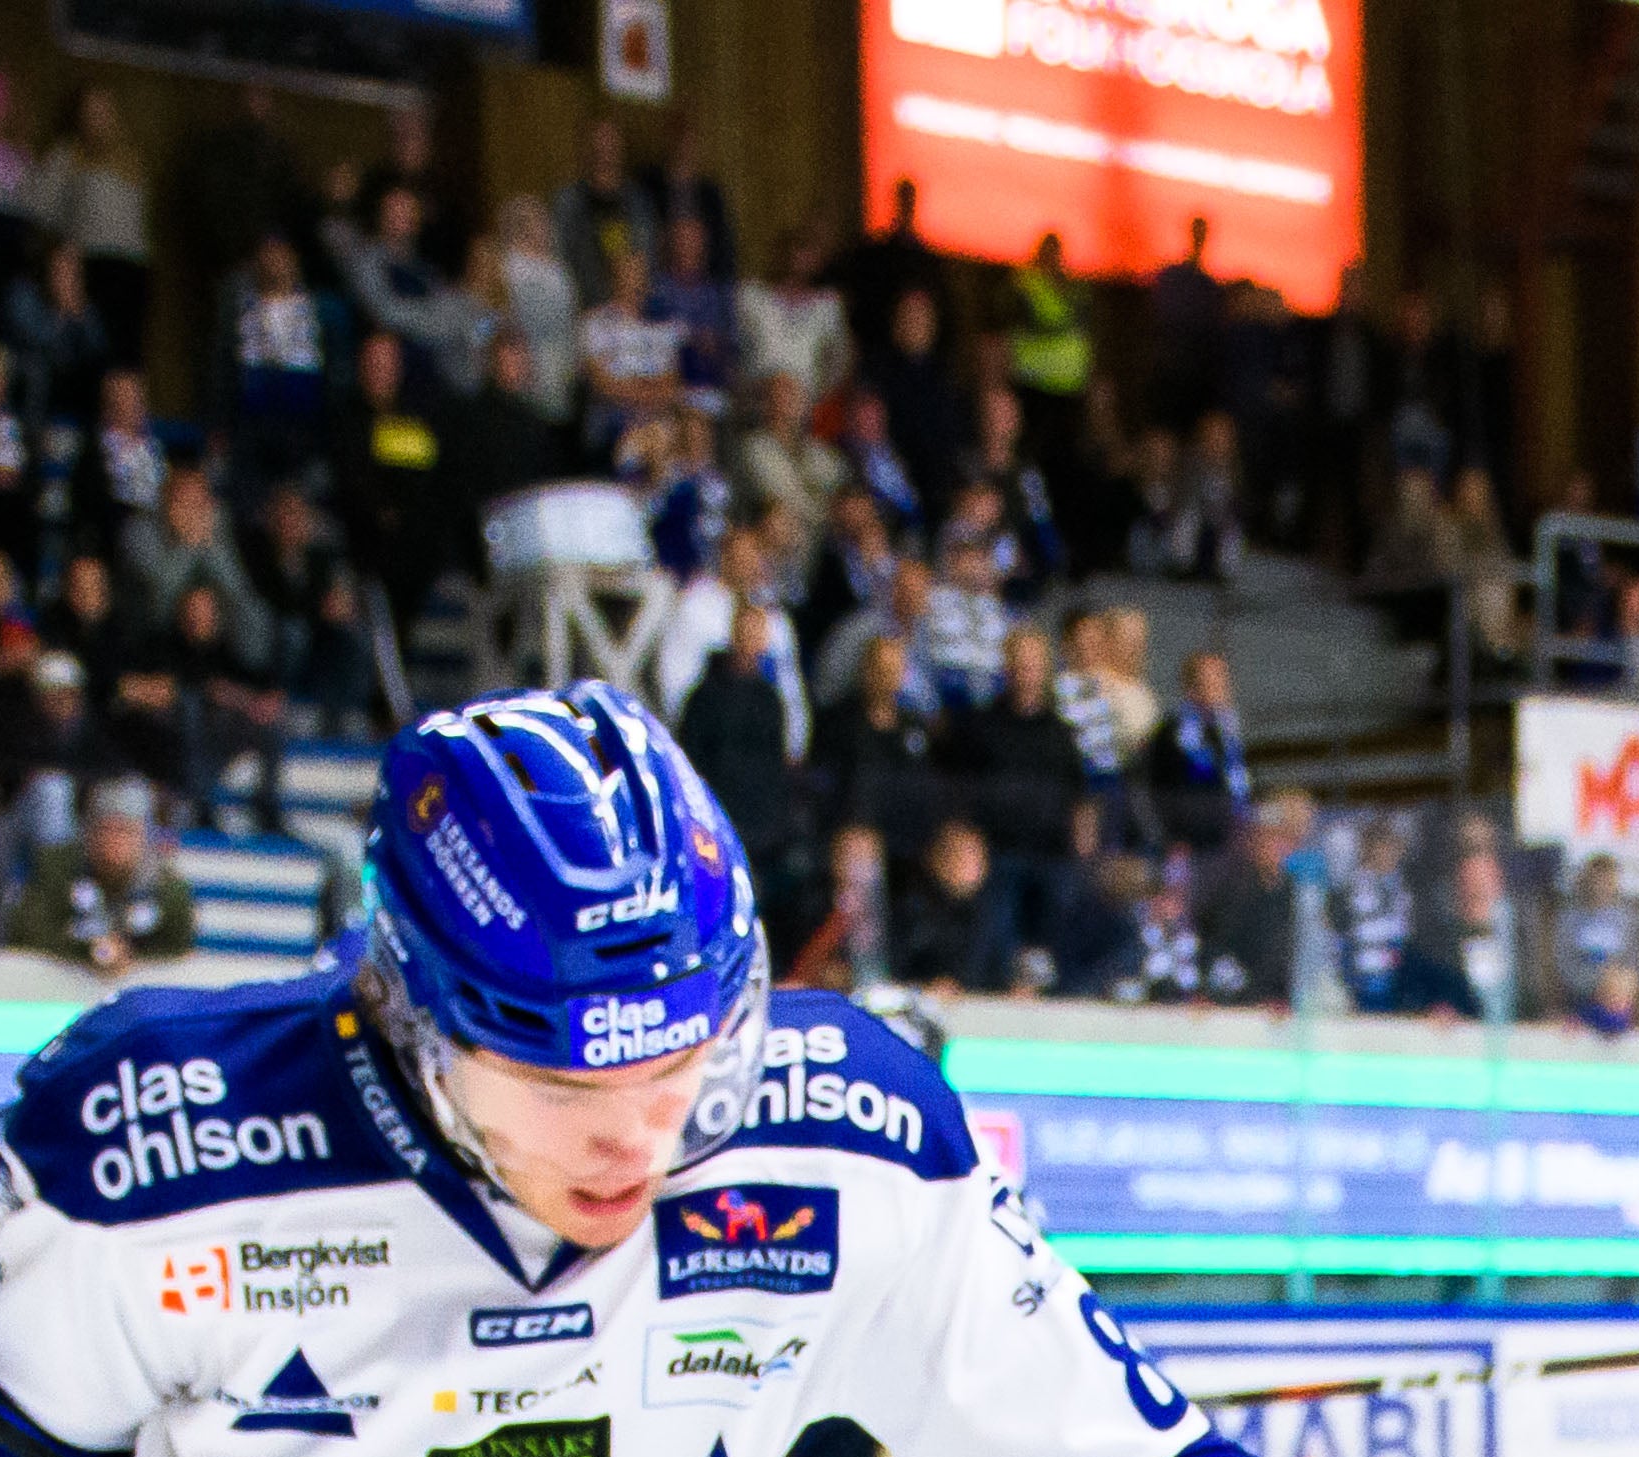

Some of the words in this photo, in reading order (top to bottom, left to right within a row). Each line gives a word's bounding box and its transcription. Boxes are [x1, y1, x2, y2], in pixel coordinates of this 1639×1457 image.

[575, 880, 680, 934] CCM
[582, 1012, 711, 1068] ohlson
[583, 998, 667, 1036] clas
[80, 1057, 228, 1136] clas
[345, 1039, 430, 1176] TEGERA
[694, 1062, 924, 1155] ohlson
[91, 1108, 332, 1201] ohlson
[238, 1238, 390, 1275] Bergkvist
[667, 1248, 832, 1283] LEKSANDS
[242, 1280, 351, 1317] Insjön
[474, 1307, 592, 1342] CCM
